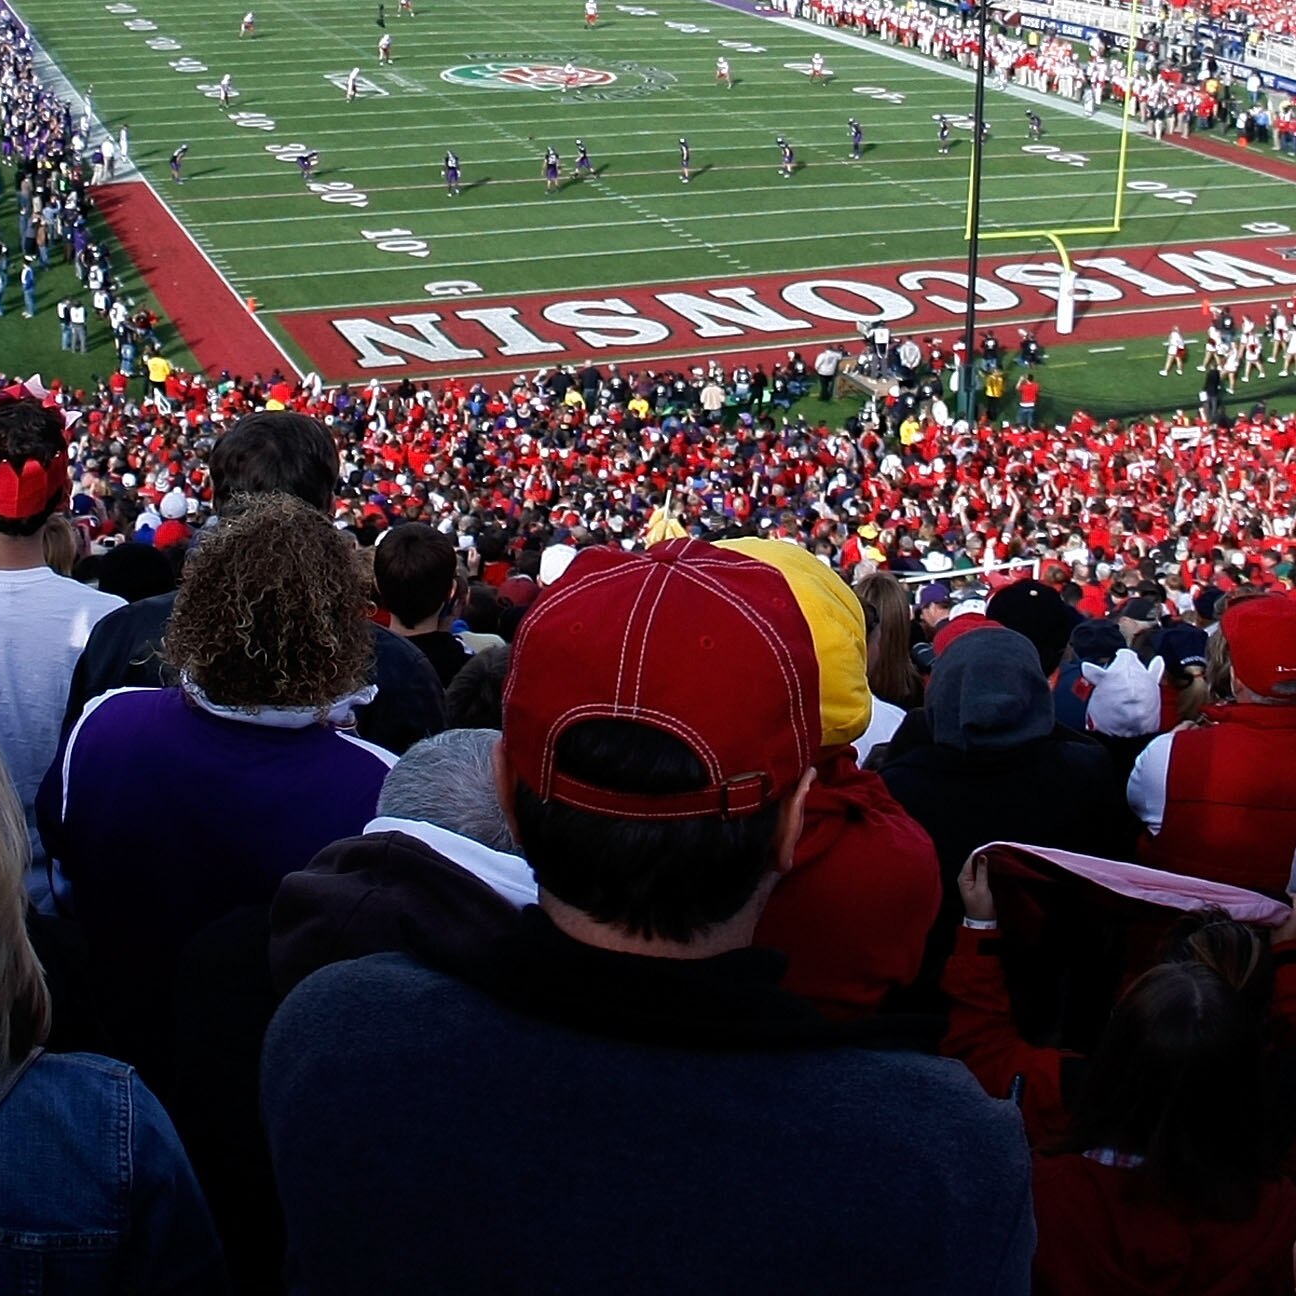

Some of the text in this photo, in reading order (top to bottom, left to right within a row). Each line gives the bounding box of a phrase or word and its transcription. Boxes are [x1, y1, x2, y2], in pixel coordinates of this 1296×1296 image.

[227, 111, 276, 128] 40
[1021, 145, 1091, 163] 20
[306, 181, 368, 203] 20
[1126, 180, 1197, 200] 10
[1241, 222, 1292, 234] G
[360, 227, 429, 253] 10
[423, 279, 484, 296] G
